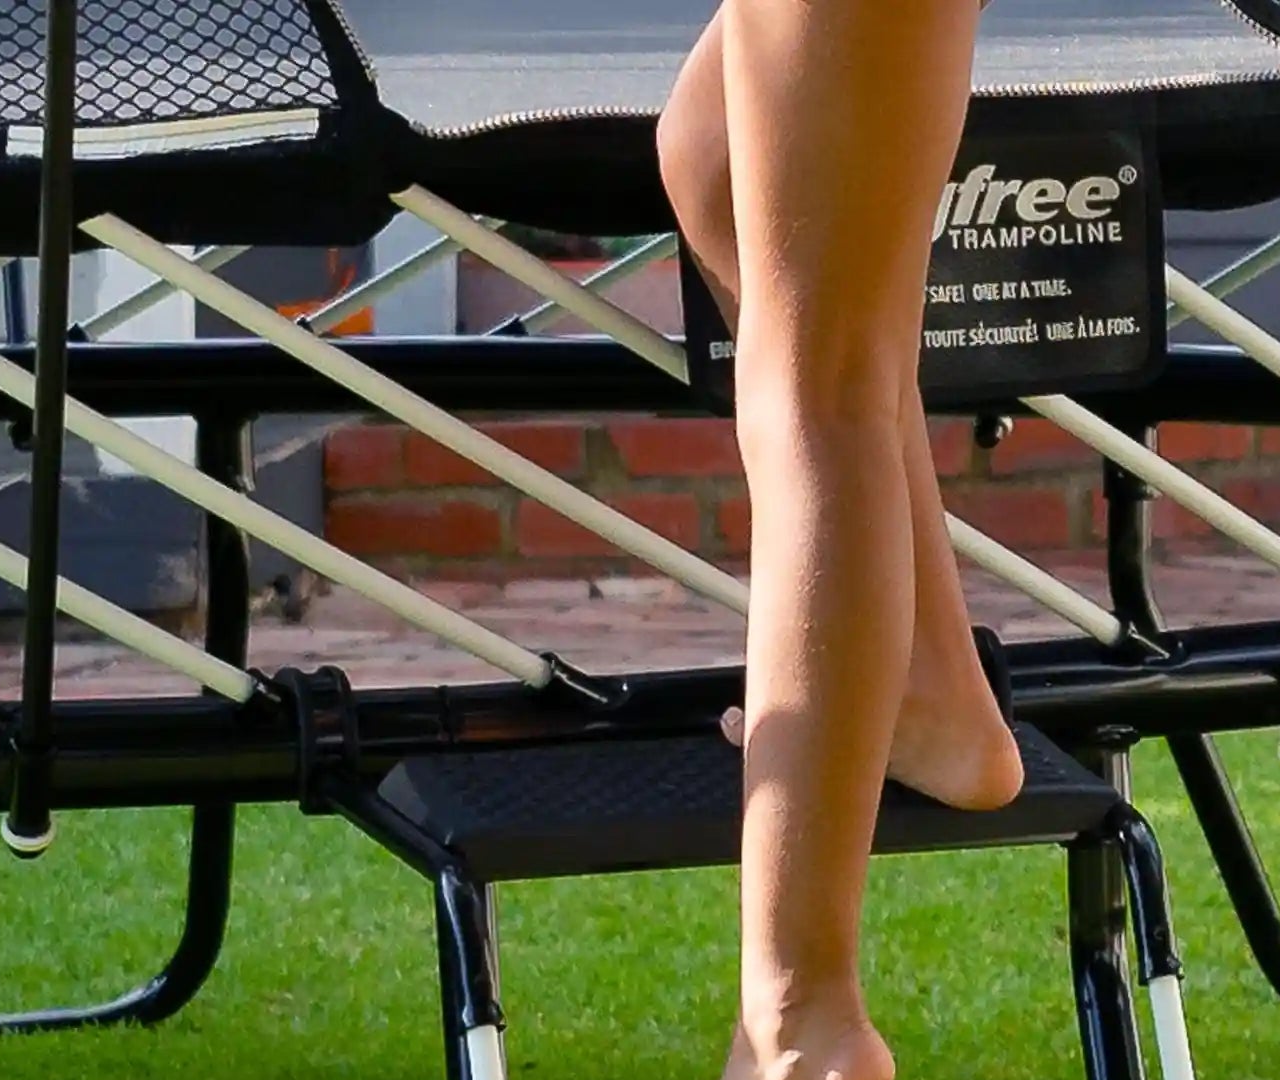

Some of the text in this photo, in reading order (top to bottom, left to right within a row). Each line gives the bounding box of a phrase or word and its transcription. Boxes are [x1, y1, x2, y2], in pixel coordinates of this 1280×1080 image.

[948, 222, 1123, 249] TRAMPOLINE
[929, 278, 1072, 303] SAFE! ONE AT A TIME.
[924, 329, 966, 348] TOUTE
[1045, 321, 1074, 341] UNE
[1077, 314, 1087, 339] À
[1089, 319, 1104, 337] LA
[1107, 316, 1140, 337] FOIS.
